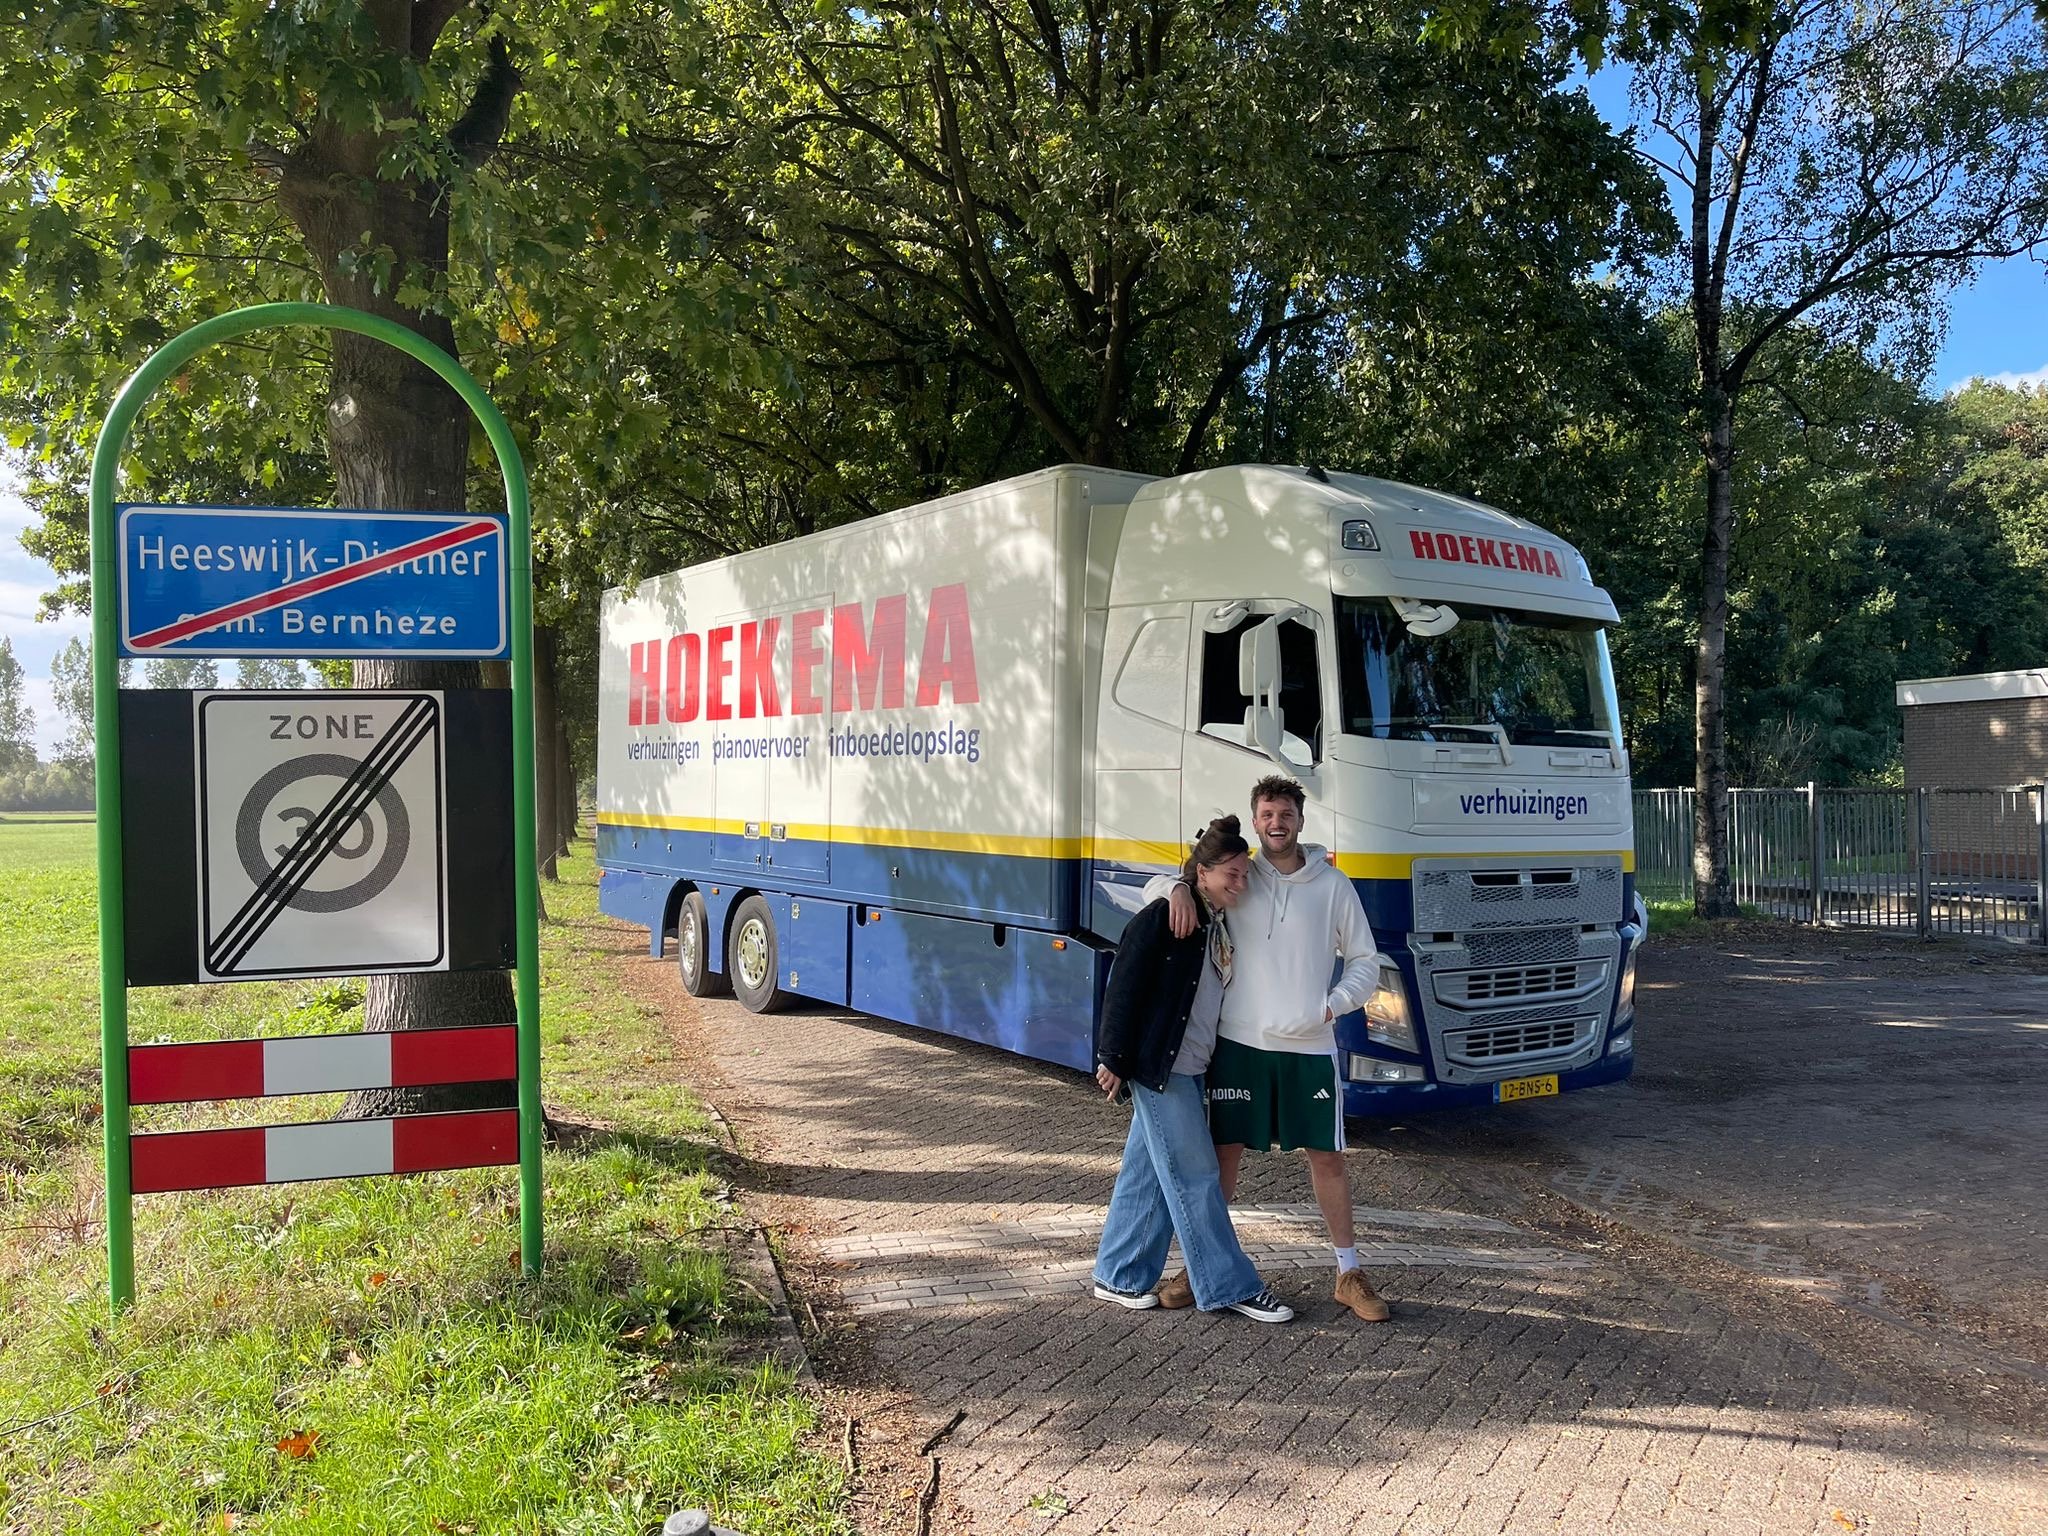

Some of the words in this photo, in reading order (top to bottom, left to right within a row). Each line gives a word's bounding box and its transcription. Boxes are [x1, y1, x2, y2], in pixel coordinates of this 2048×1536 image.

[1409, 531, 1562, 577] HOEKEMA
[282, 609, 457, 635] Bernheze
[628, 582, 980, 727] HOEKEMA
[269, 714, 375, 740] ZONE
[628, 736, 700, 764] verhuizingen
[713, 734, 809, 763] pianovervoer
[830, 721, 981, 763] inboedelopslag
[1461, 788, 1587, 820] verhuizingen
[274, 806, 374, 860] 30
[1212, 1088, 1251, 1101] ADIDAS
